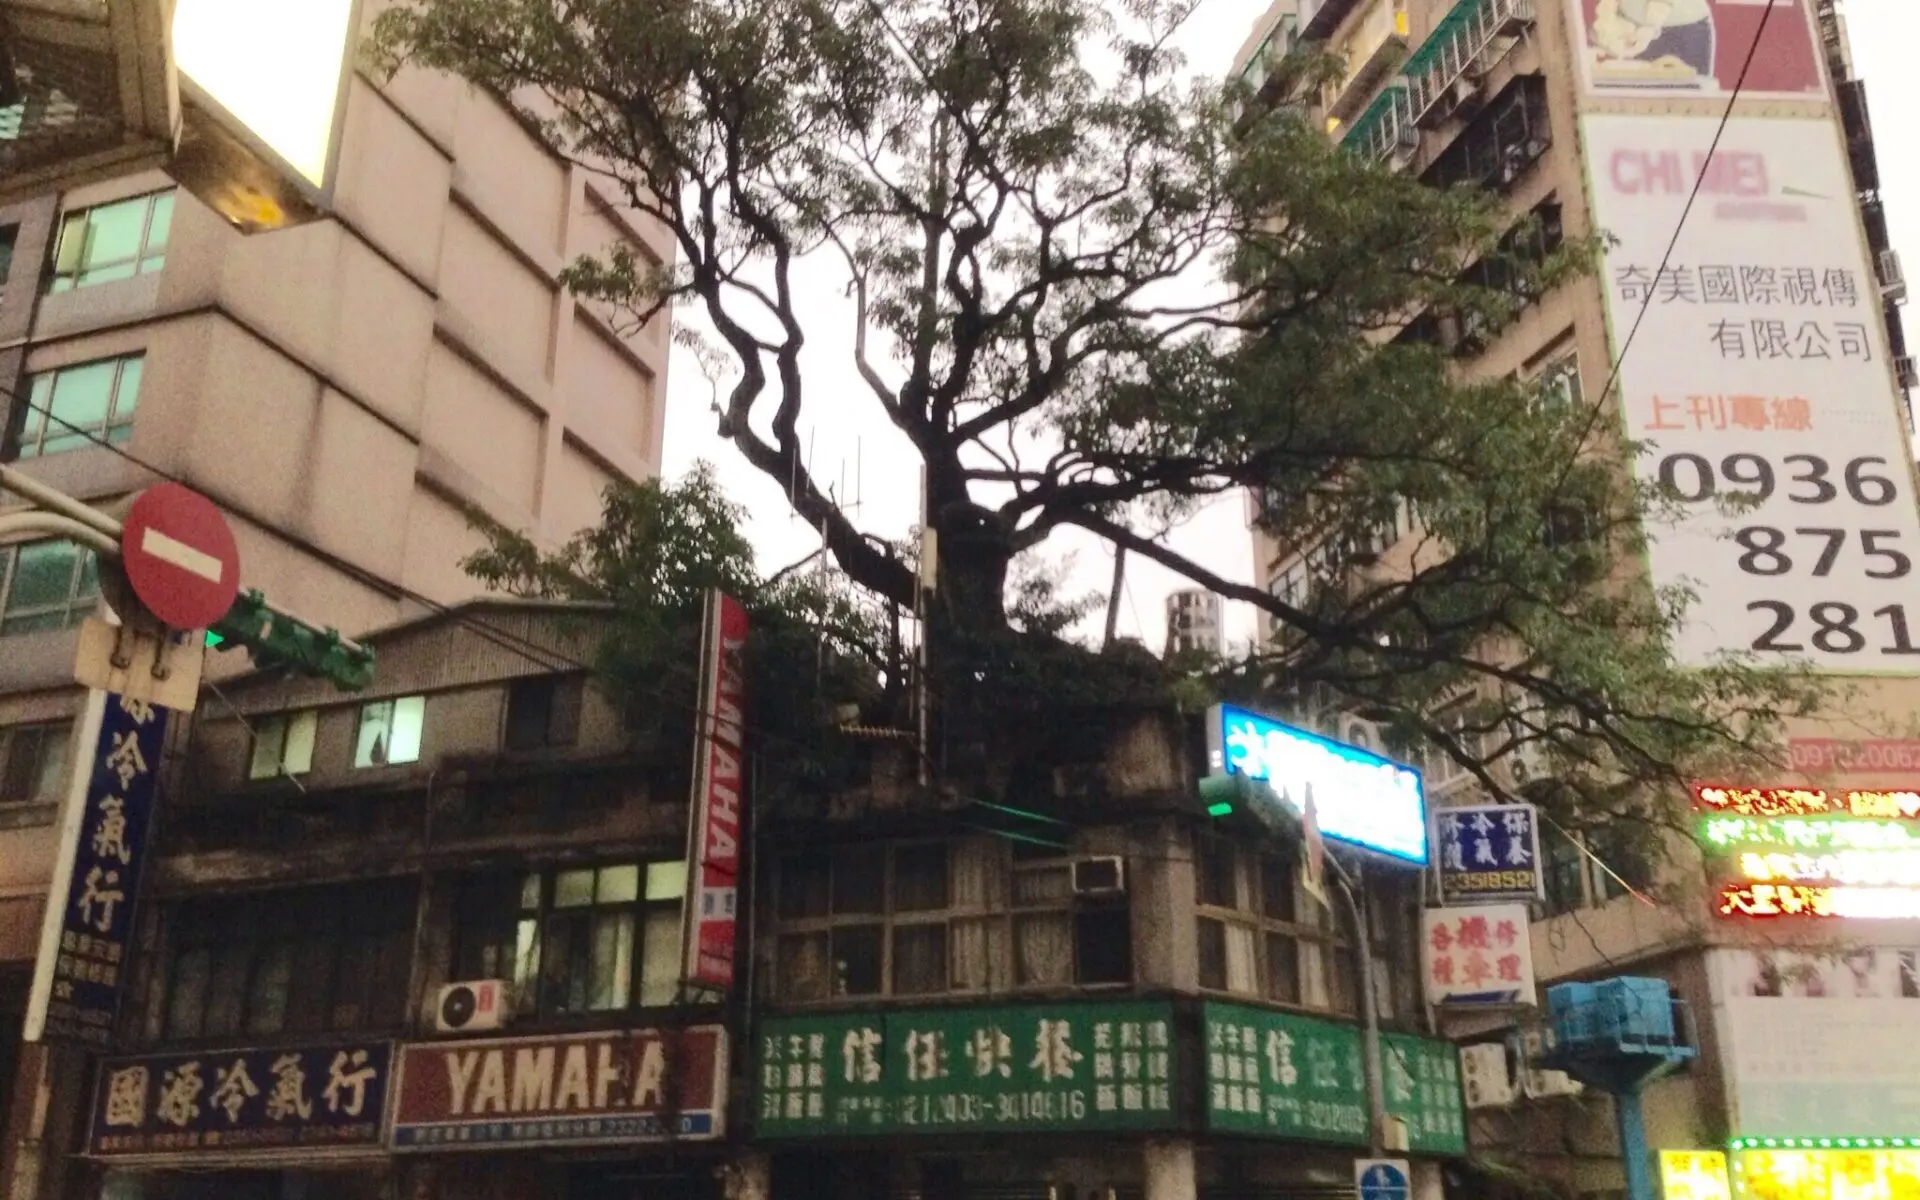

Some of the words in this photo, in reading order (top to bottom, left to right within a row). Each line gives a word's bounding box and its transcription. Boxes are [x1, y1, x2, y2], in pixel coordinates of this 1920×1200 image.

[1615, 263, 1860, 308] 奇美國際視傳
[1708, 318, 1873, 363] 有限公司
[1643, 394, 1814, 433] 上刊專線
[1658, 452, 1898, 507] 0936
[1735, 525, 1912, 580] 875
[1746, 599, 1920, 655] 281
[104, 1048, 378, 1127] 國源冷氣行
